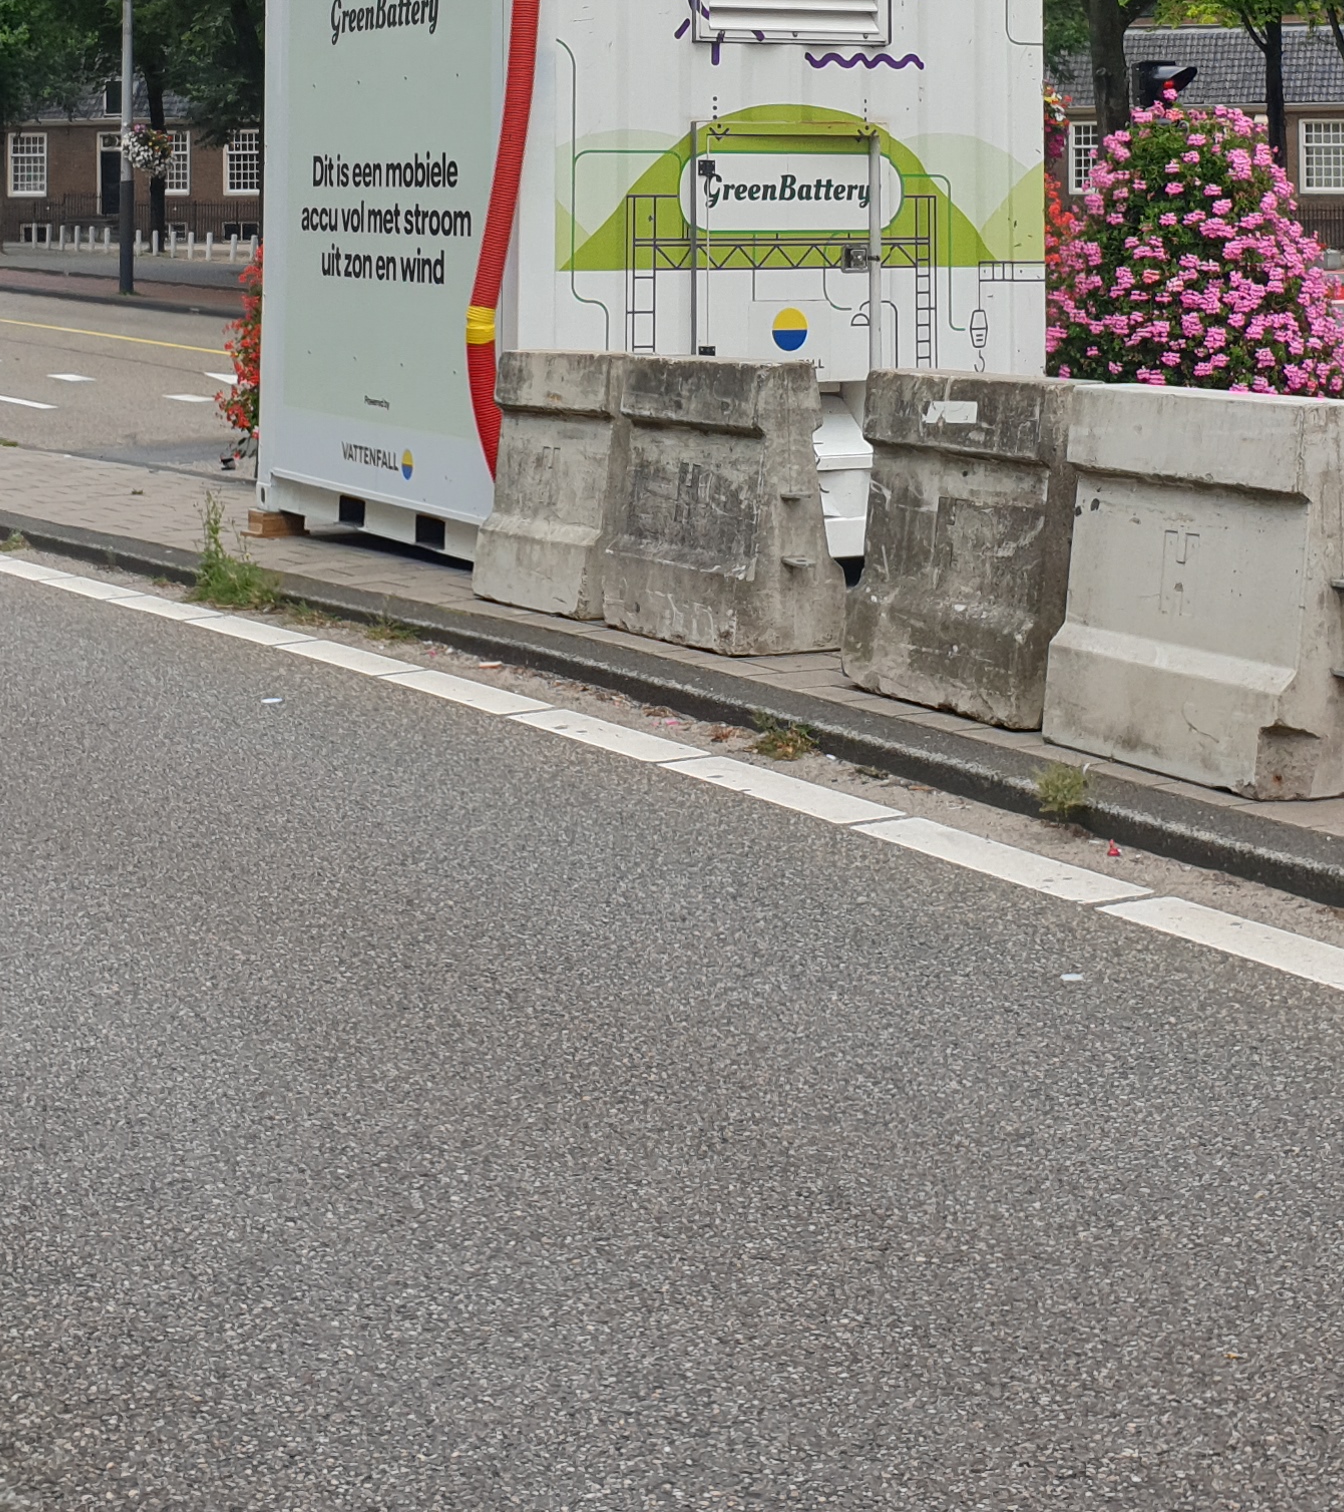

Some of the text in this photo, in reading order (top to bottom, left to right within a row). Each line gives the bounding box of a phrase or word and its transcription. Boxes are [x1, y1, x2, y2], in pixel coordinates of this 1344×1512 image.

[312, 151, 459, 188] Dit is een mobiele
[703, 173, 871, 209] GreenBattery
[301, 200, 472, 237] accu vol met stroom
[321, 243, 445, 285] uit zon en wind
[341, 441, 399, 471] VATTENFALL
